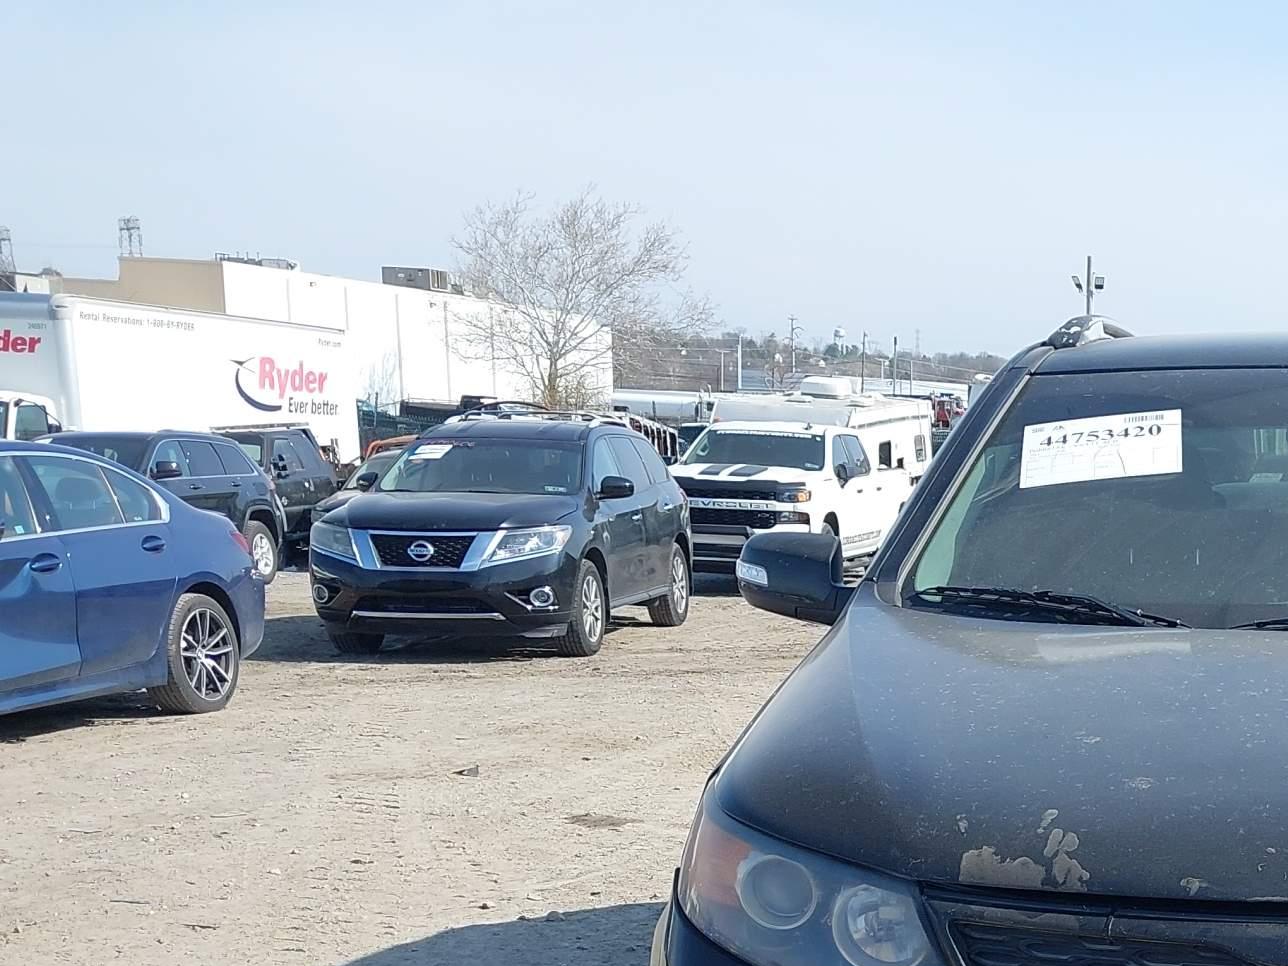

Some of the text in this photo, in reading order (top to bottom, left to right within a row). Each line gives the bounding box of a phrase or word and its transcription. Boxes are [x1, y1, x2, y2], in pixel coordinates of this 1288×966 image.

[0, 329, 42, 353] der
[258, 356, 328, 400] Ryder
[288, 396, 339, 416] Ever better
[1039, 424, 1162, 447] 44753420
[689, 498, 777, 511] EVROLET
